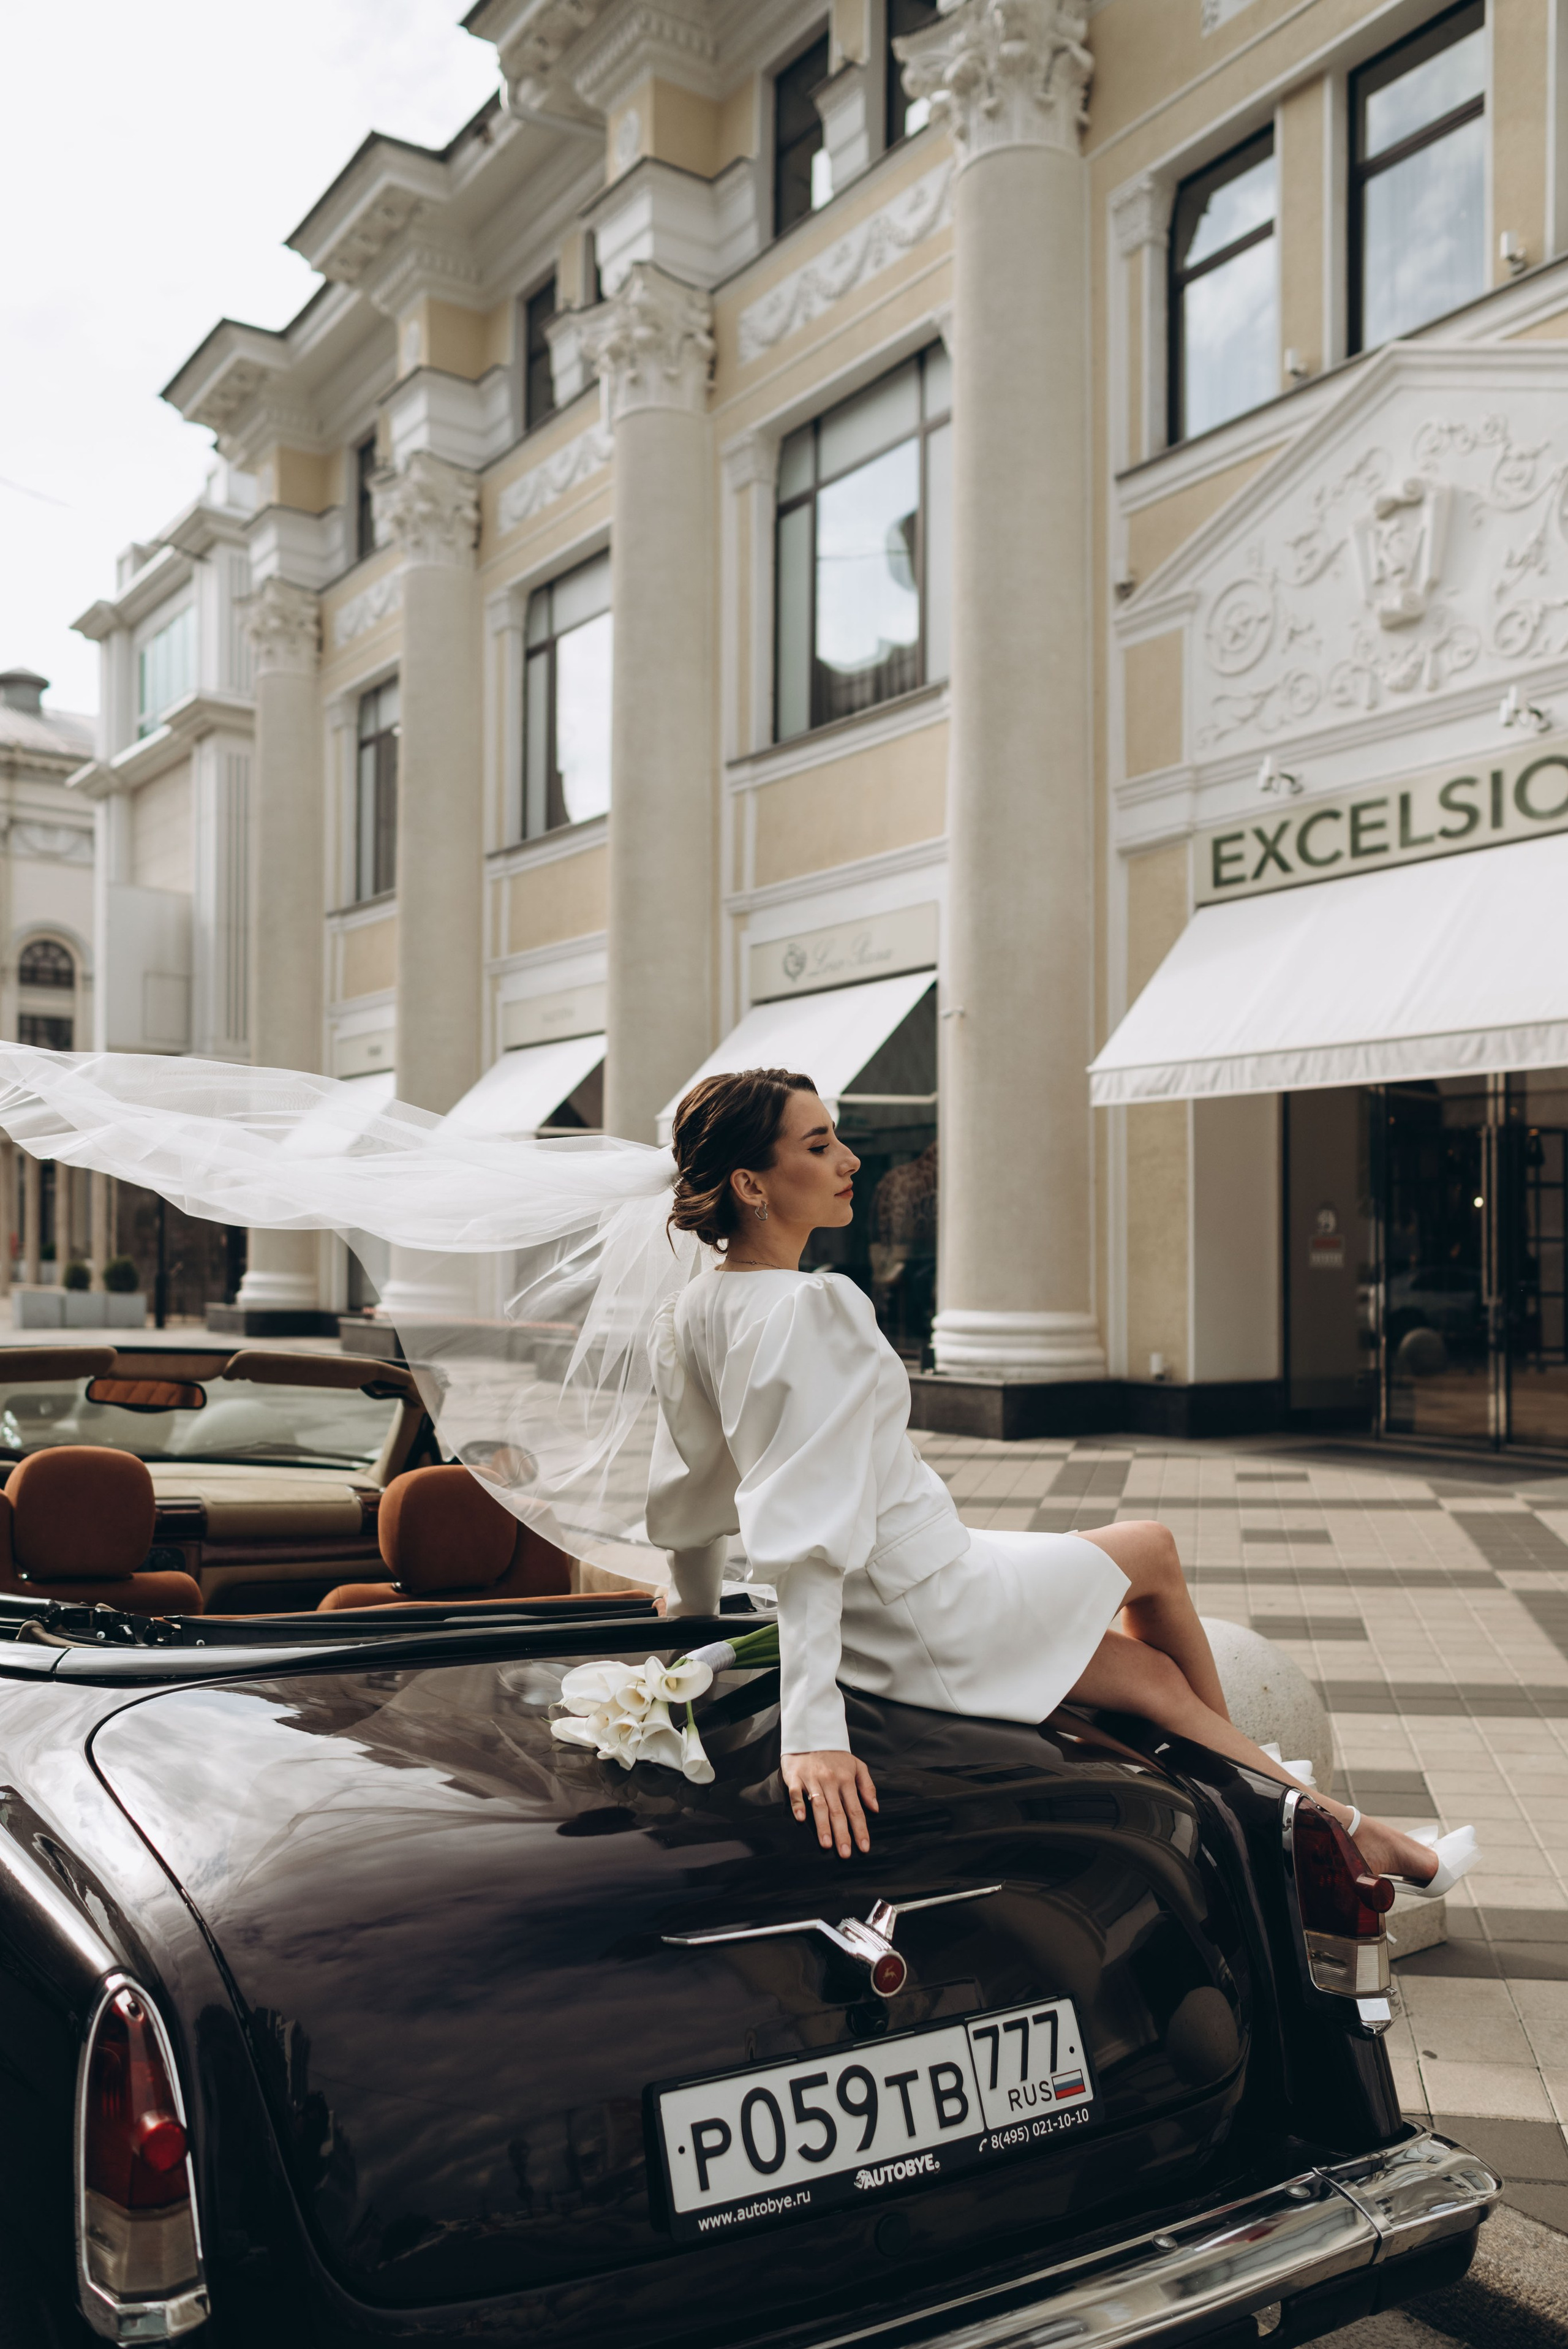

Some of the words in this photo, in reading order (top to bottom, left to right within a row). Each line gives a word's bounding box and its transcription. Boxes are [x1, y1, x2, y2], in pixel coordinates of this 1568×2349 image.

[1212, 754, 1568, 889] EXCELSIO
[972, 2009, 1058, 2090] 777
[1008, 2080, 1052, 2112] RUS
[990, 2125, 1030, 2149] 8(495)
[1032, 2108, 1089, 2136] 021-10-10
[698, 2190, 812, 2231] www.autobye.ru
